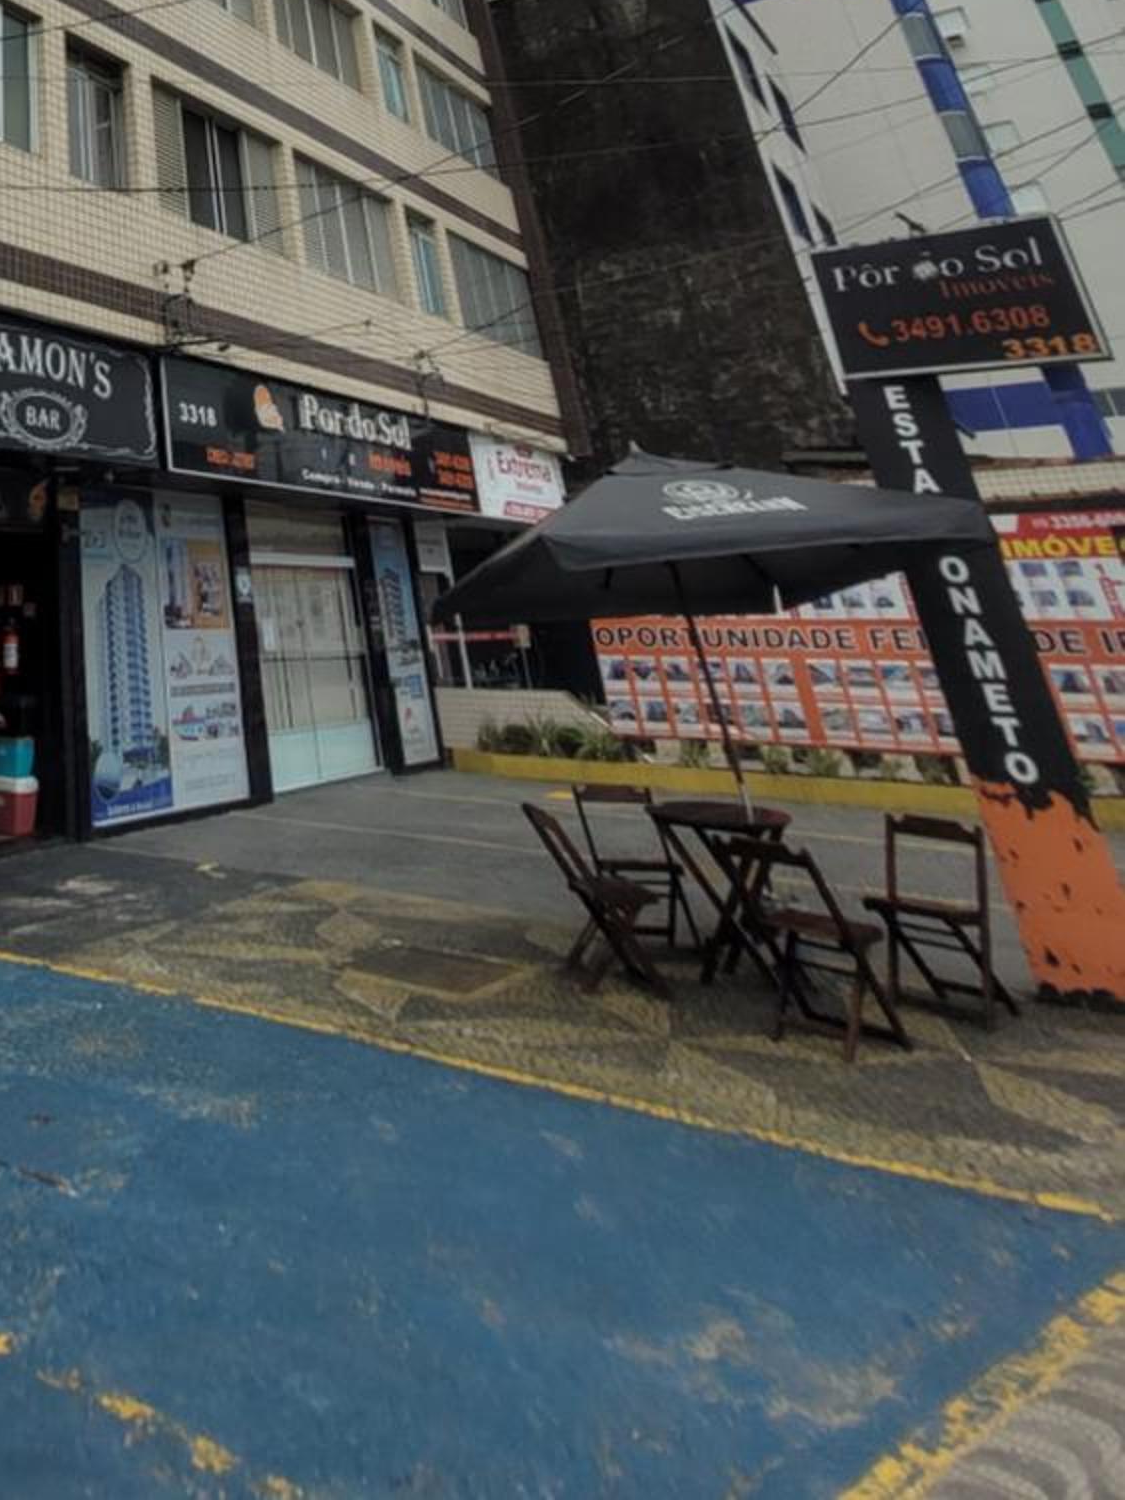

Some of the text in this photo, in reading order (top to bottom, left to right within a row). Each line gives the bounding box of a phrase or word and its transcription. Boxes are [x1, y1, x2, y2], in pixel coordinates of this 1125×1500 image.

[976, 237, 1043, 273] Sol
[890, 304, 1051, 343] 3491.6308
[1002, 331, 1097, 358] 3318
[26, 405, 61, 431] BAR
[179, 402, 217, 427] 3318
[378, 412, 412, 450] Sol
[884, 384, 1039, 784] ESTAONAMETO
[594, 626, 857, 650] OPORTUNIDADE
